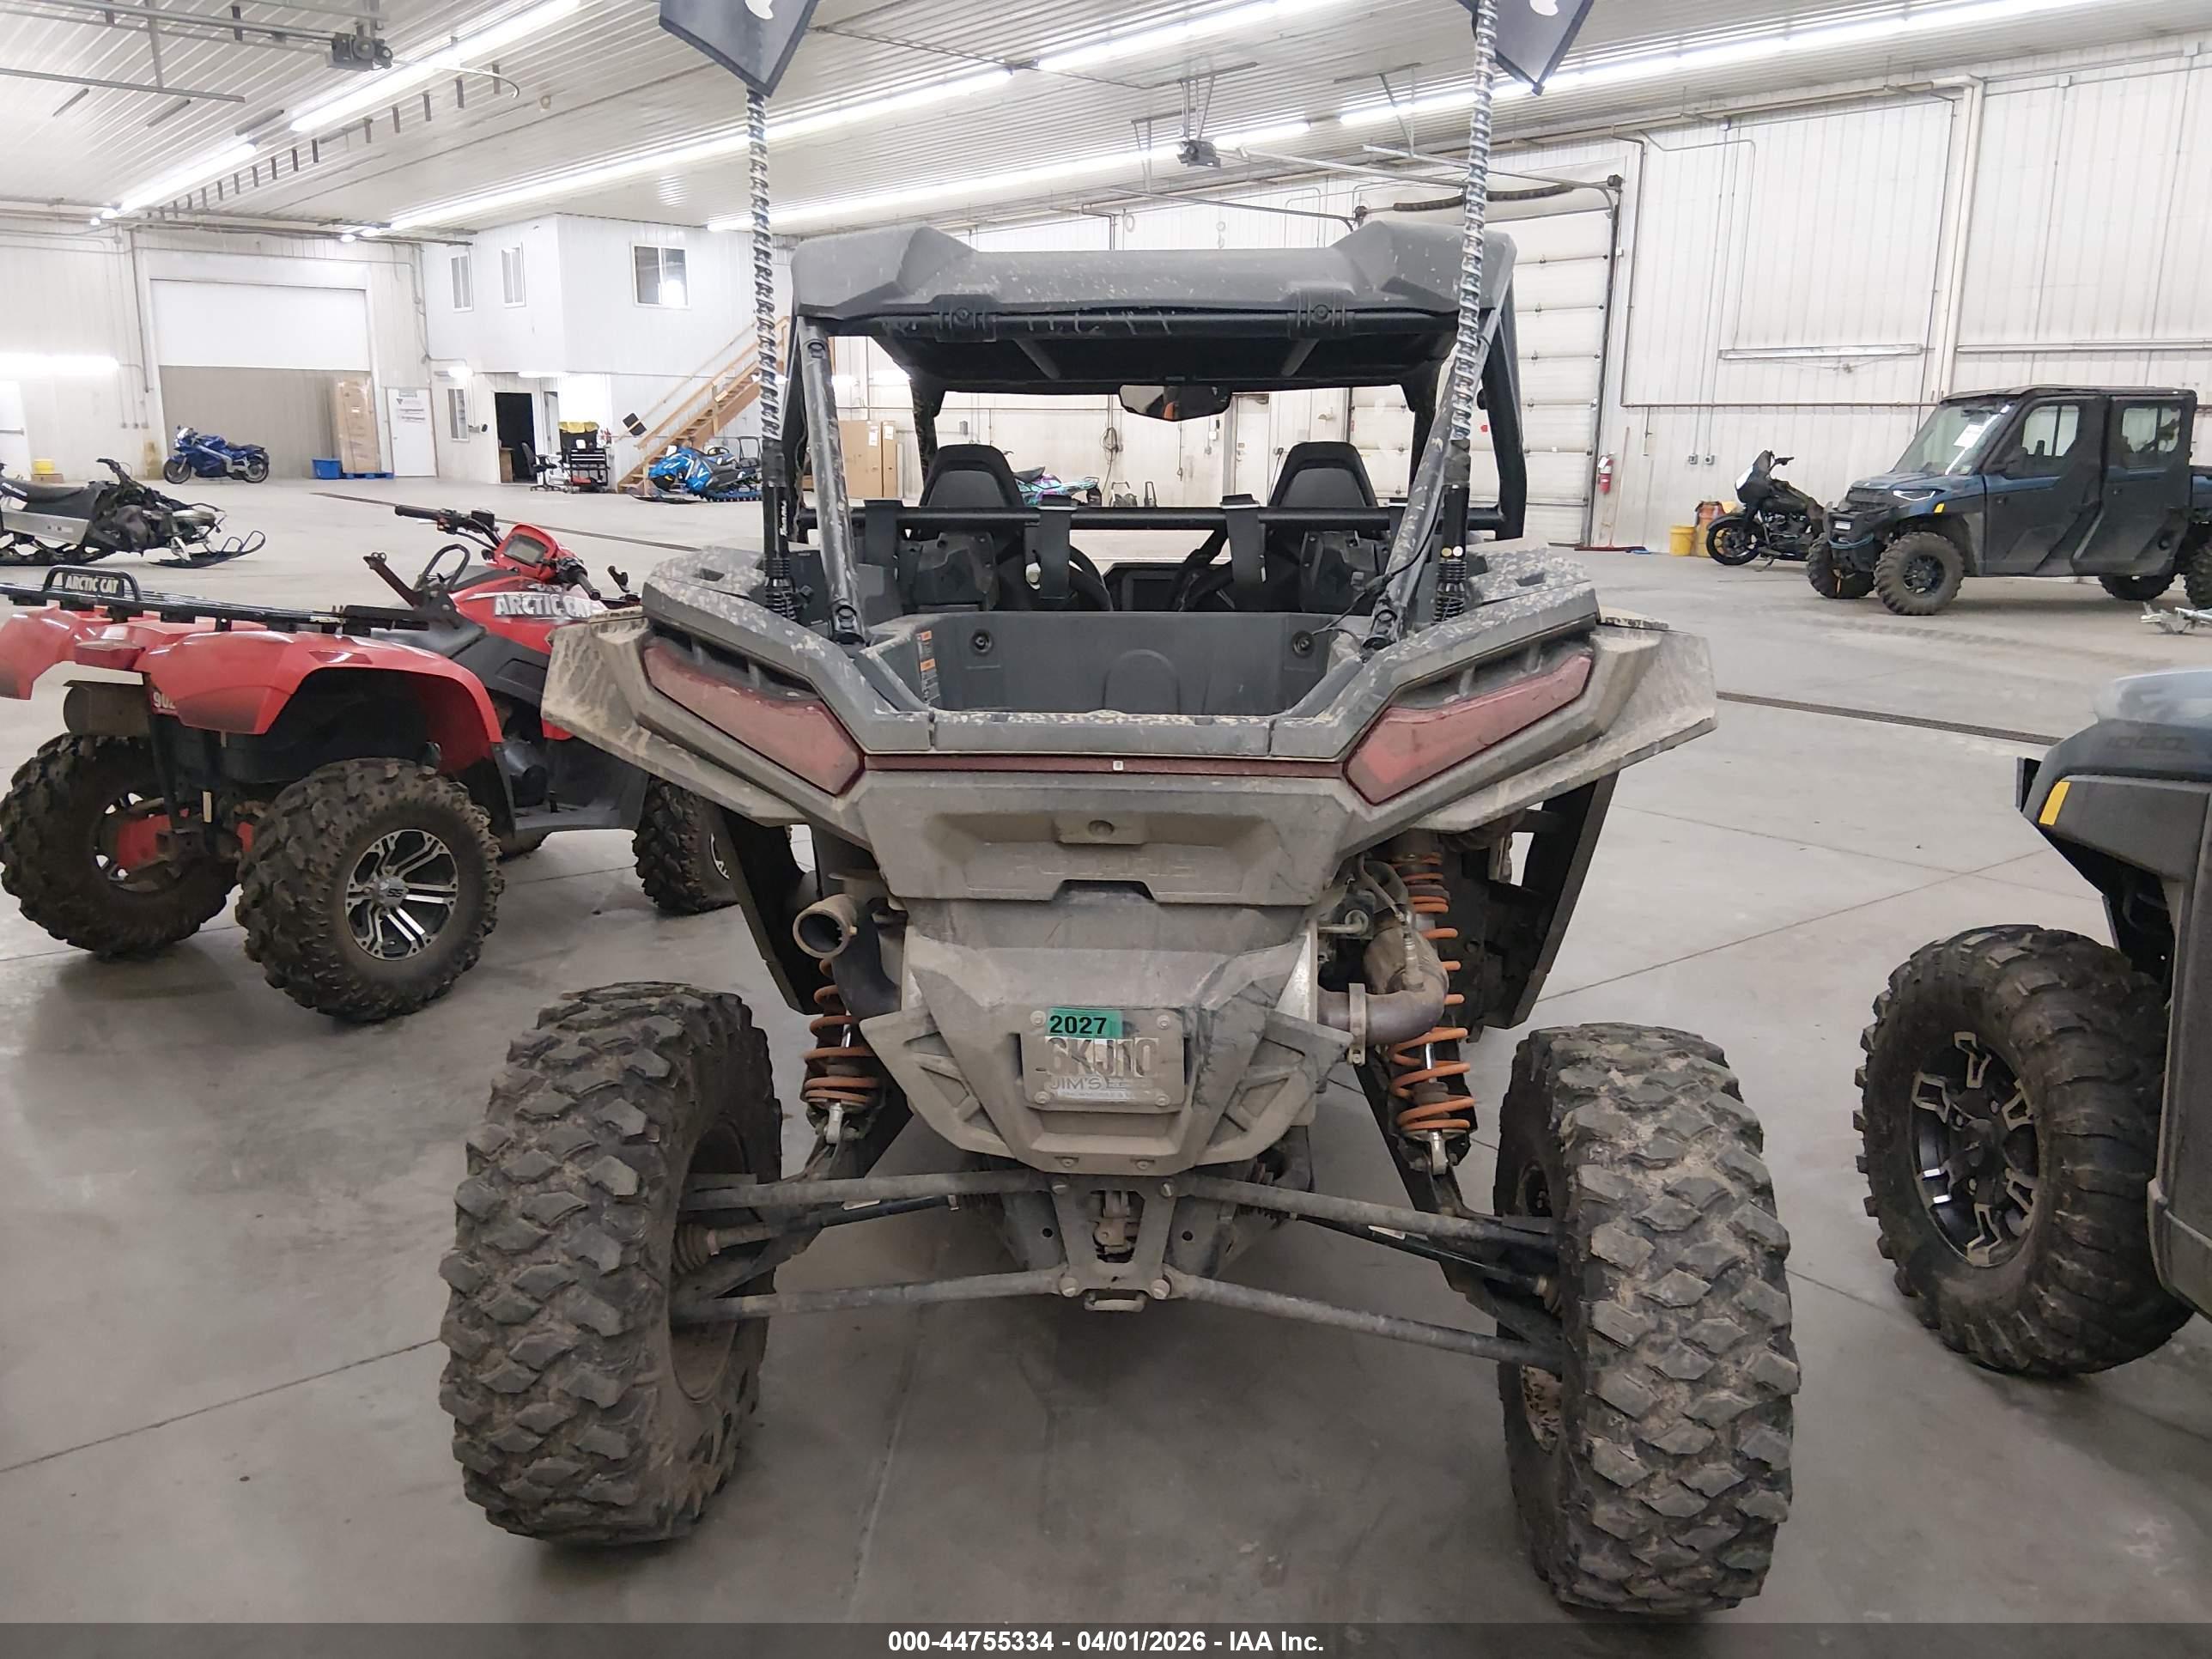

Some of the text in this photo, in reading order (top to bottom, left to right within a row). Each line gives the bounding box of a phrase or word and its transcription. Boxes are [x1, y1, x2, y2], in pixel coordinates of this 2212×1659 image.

[65, 575, 118, 594] ARCTIC CAT
[495, 594, 562, 616] ARCTIC
[1049, 1015, 1107, 1035] 2027
[1051, 1076, 1101, 1091] JIM'S
